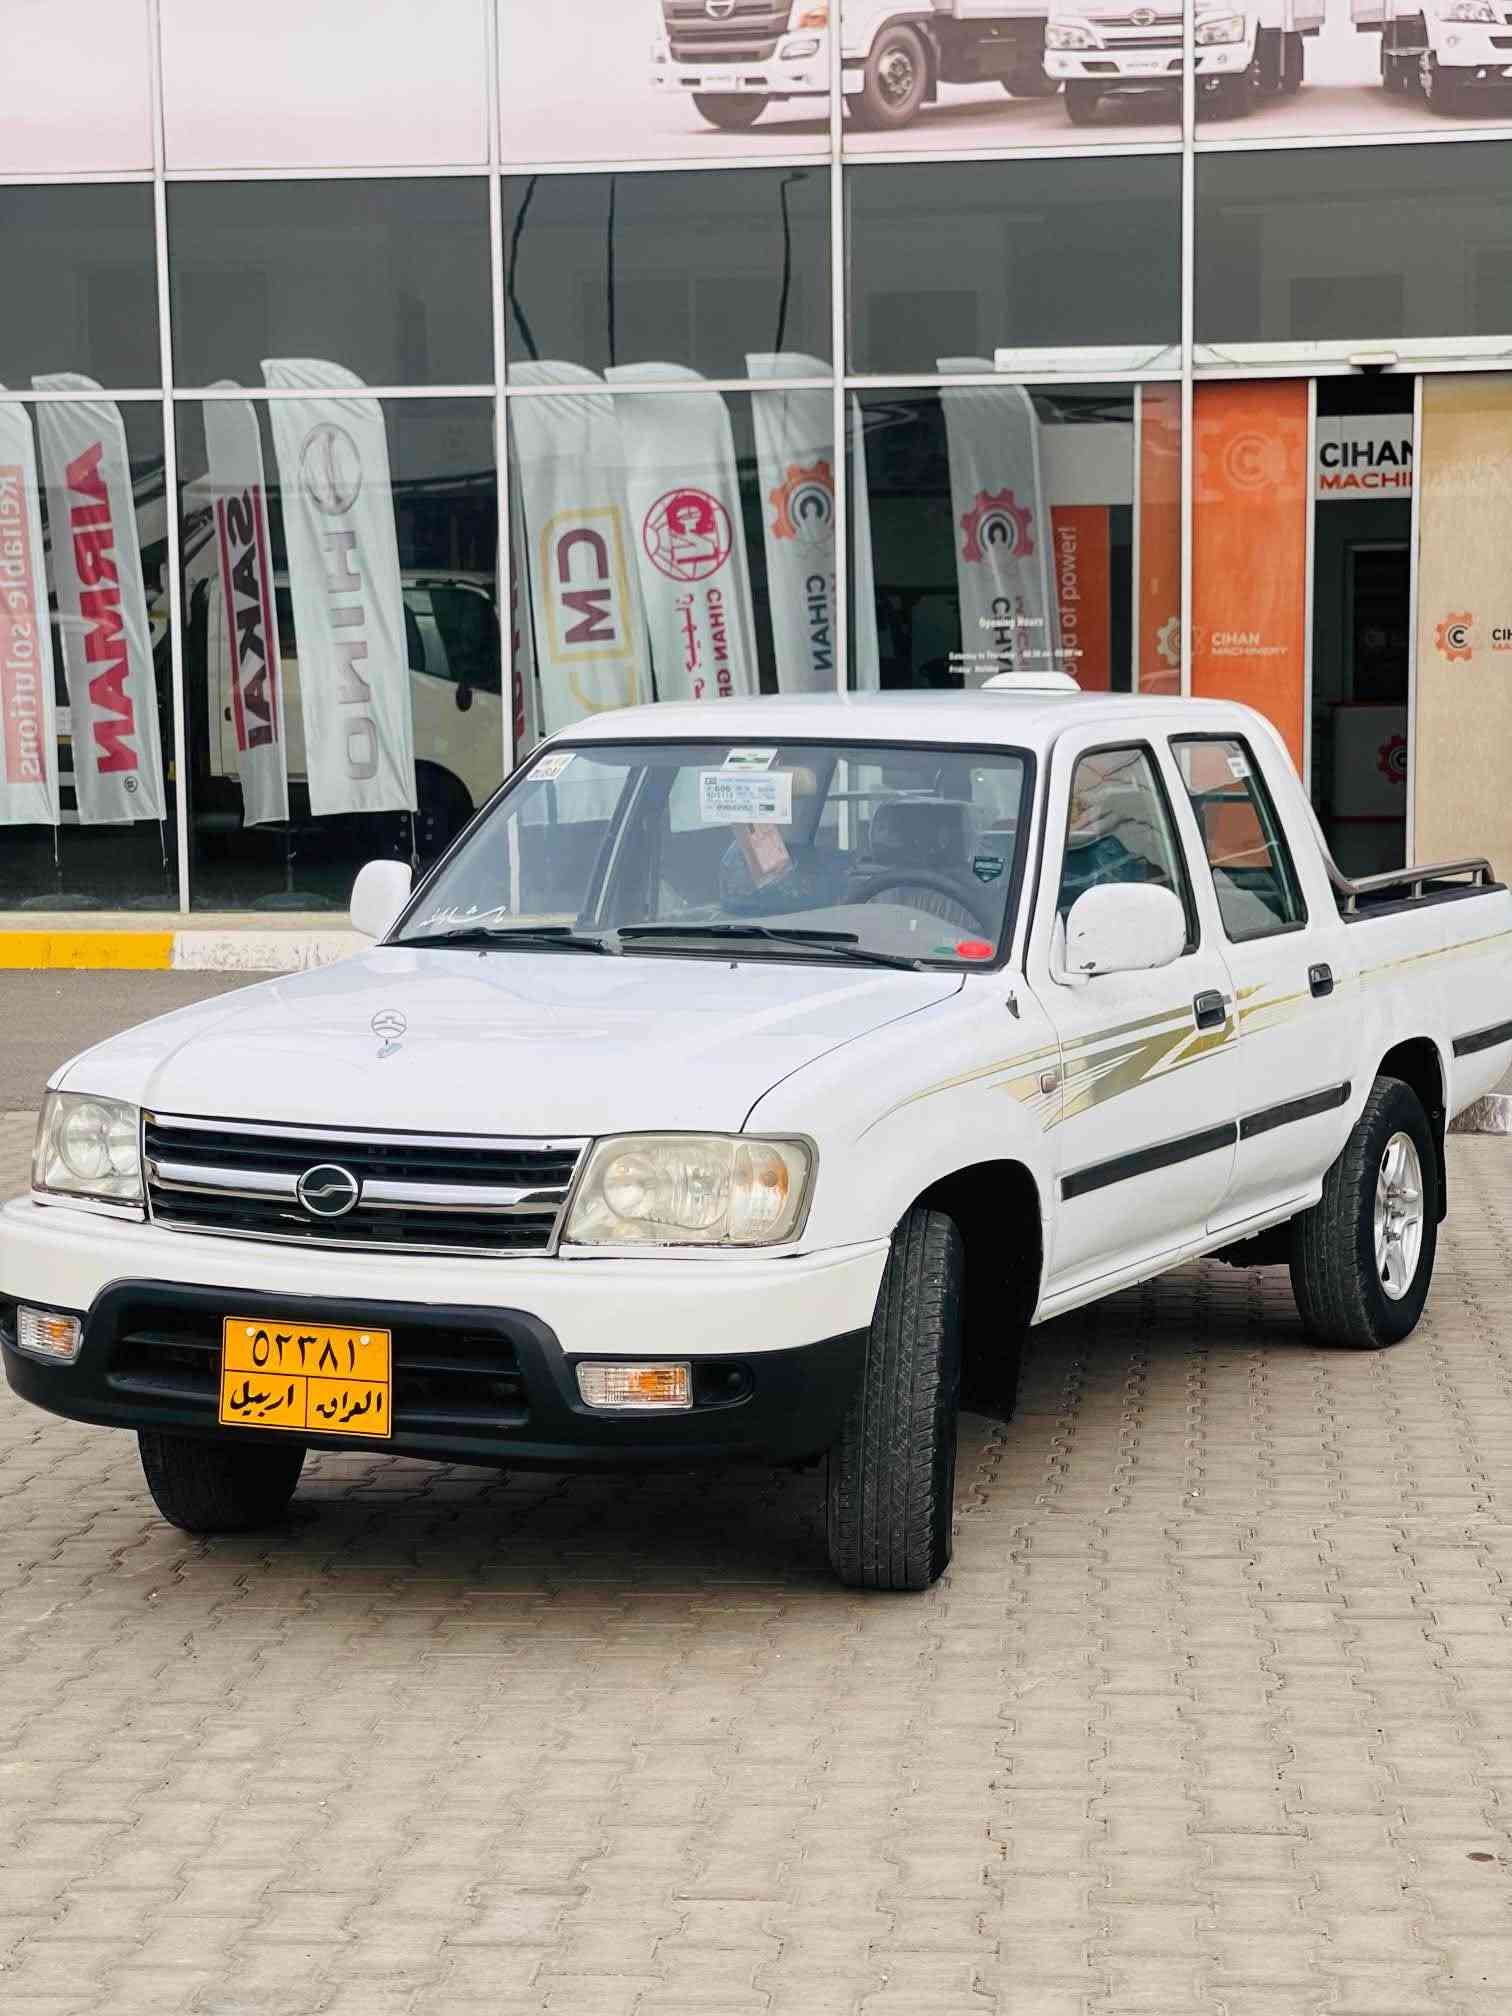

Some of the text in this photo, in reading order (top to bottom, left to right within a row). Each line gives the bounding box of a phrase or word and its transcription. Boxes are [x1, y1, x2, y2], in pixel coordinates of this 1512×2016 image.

[1319, 440, 1412, 468] CIHAN
[1057, 526, 1080, 600] power!
[1211, 631, 1261, 647] CIHAN
[252, 1329, 356, 1372] ٥٢٣٨١
[230, 1379, 295, 1418] اربيل
[315, 1389, 383, 1423] العراق
